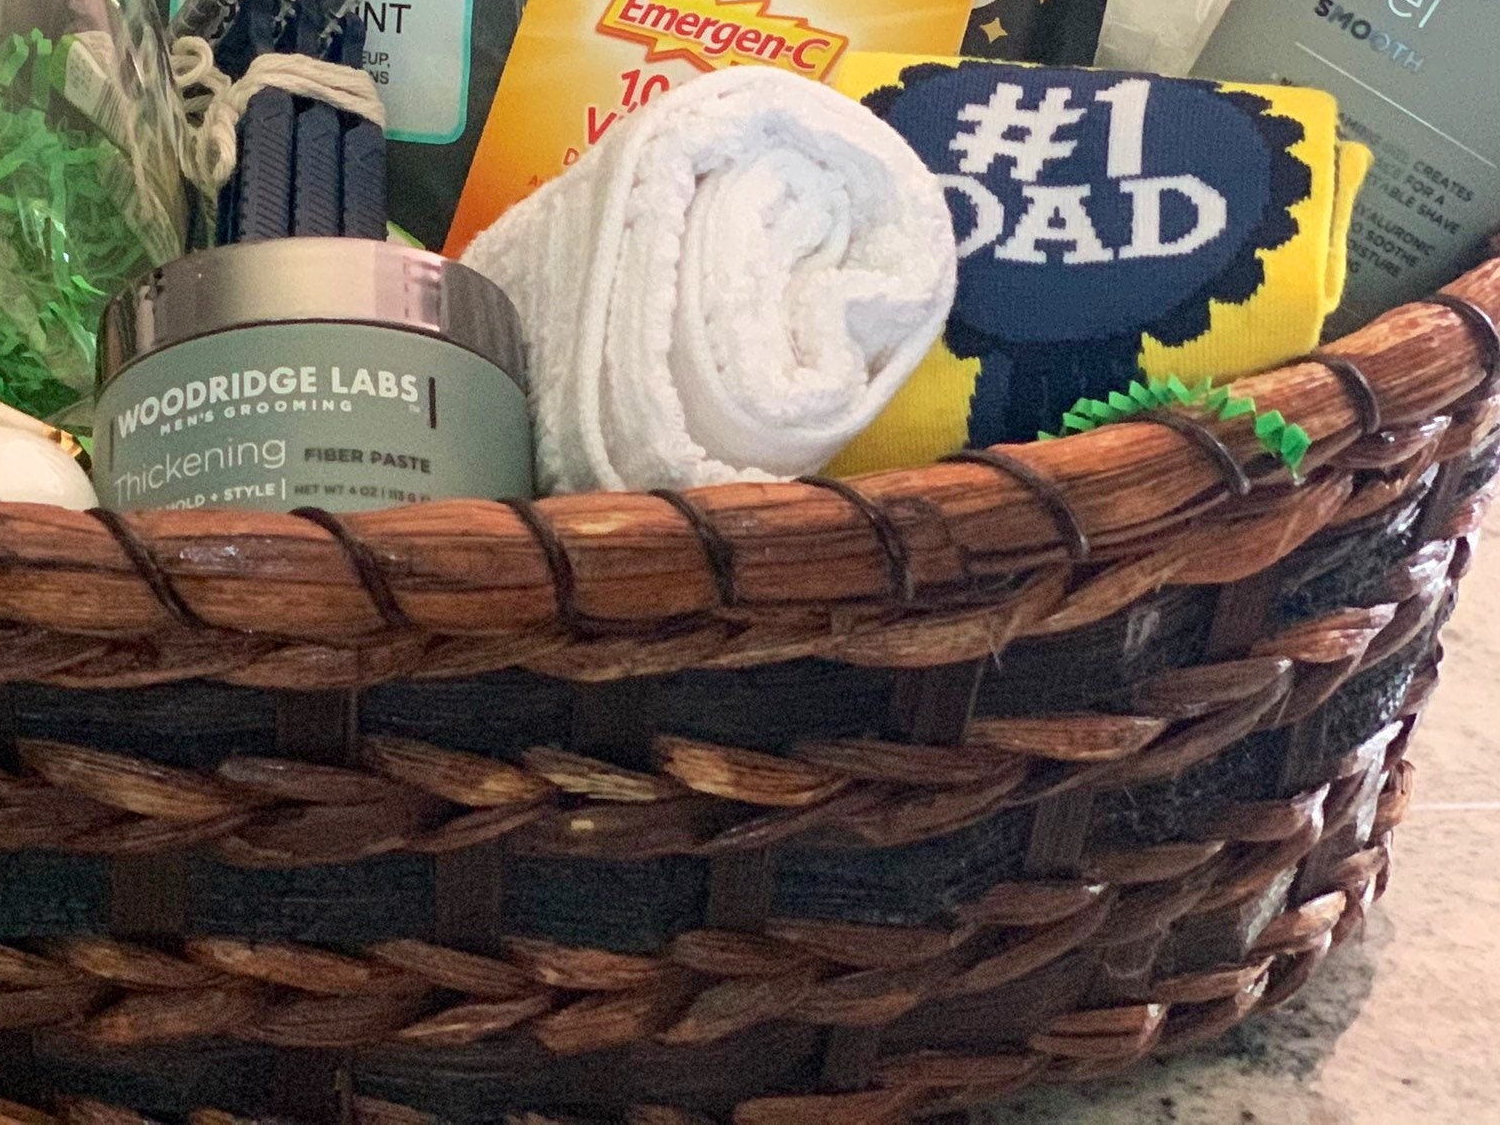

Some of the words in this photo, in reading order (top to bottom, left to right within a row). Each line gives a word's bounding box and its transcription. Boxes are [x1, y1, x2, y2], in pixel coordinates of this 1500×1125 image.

[949, 78, 1151, 182] #1
[1406, 176, 1434, 197] FOR
[1435, 195, 1446, 206] A
[1413, 160, 1475, 203] CREATES
[937, 174, 1228, 265] DAD
[1416, 204, 1460, 235] SHAVE
[1365, 230, 1419, 267] SOOTHE
[117, 366, 318, 438] WOODRIDGE
[331, 366, 419, 403] LABS
[160, 411, 215, 437] MEN'S
[223, 399, 352, 420] GROOMING
[114, 438, 287, 504] Thickening
[304, 447, 364, 463] FIBER
[371, 450, 431, 473] PASTE
[224, 483, 276, 501] STYLE
